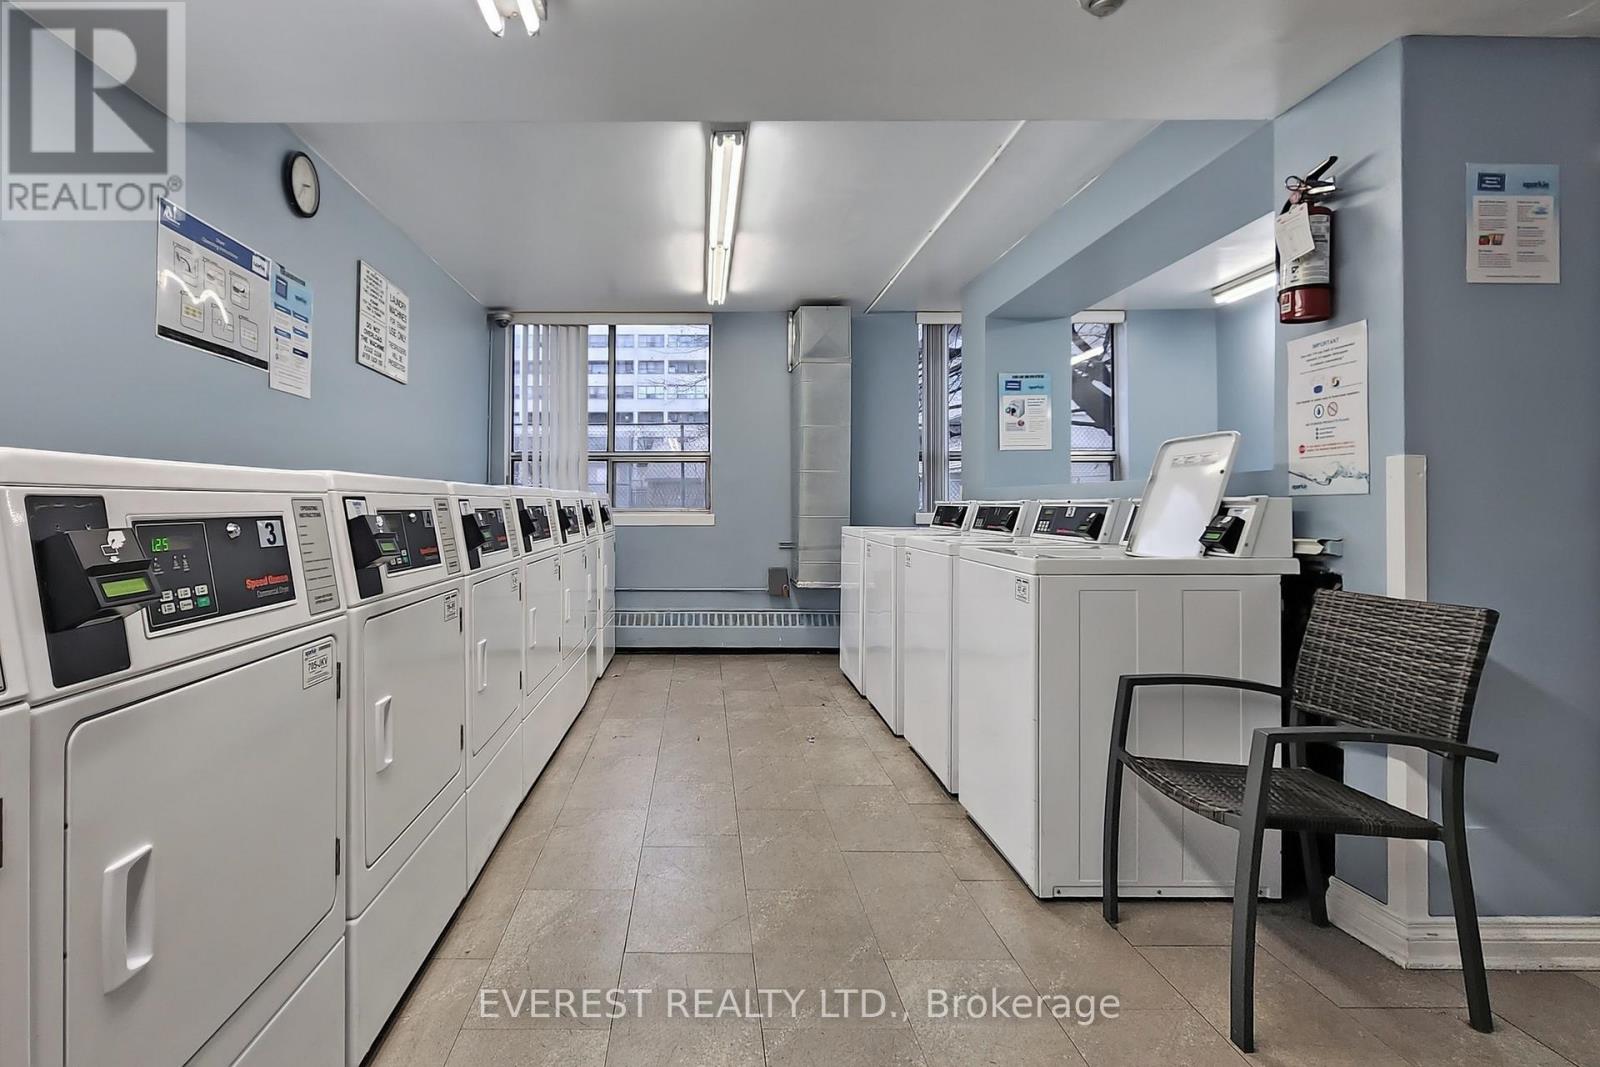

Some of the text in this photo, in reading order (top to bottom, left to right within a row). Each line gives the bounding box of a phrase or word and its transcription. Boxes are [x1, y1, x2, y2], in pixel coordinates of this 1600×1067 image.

[264, 522, 277, 545] 3
[245, 573, 289, 592] Speed Queen
